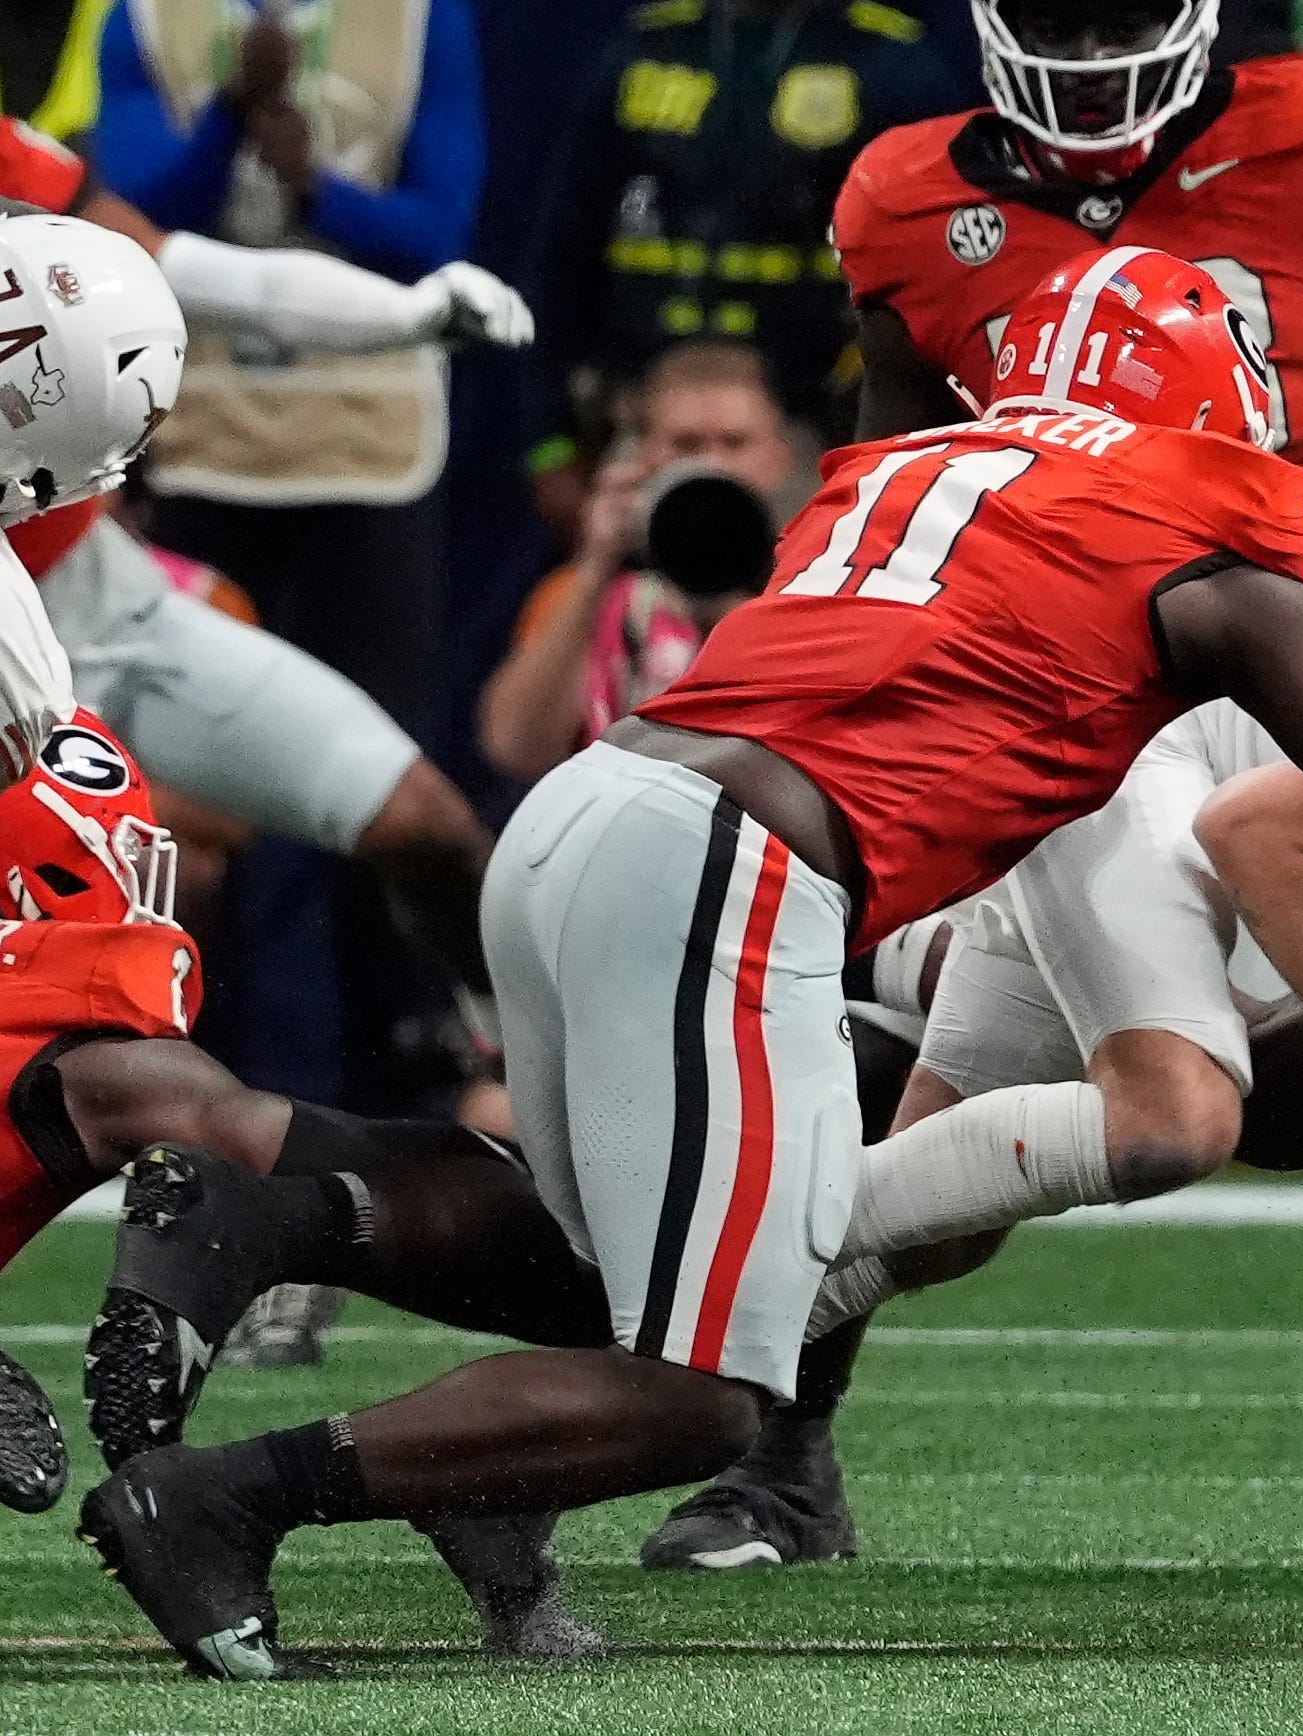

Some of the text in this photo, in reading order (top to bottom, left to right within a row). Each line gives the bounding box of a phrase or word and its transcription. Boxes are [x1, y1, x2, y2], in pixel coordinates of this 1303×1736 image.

[948, 205, 1004, 261] SEC
[778, 442, 1037, 607] 11
[43, 728, 127, 791] G
